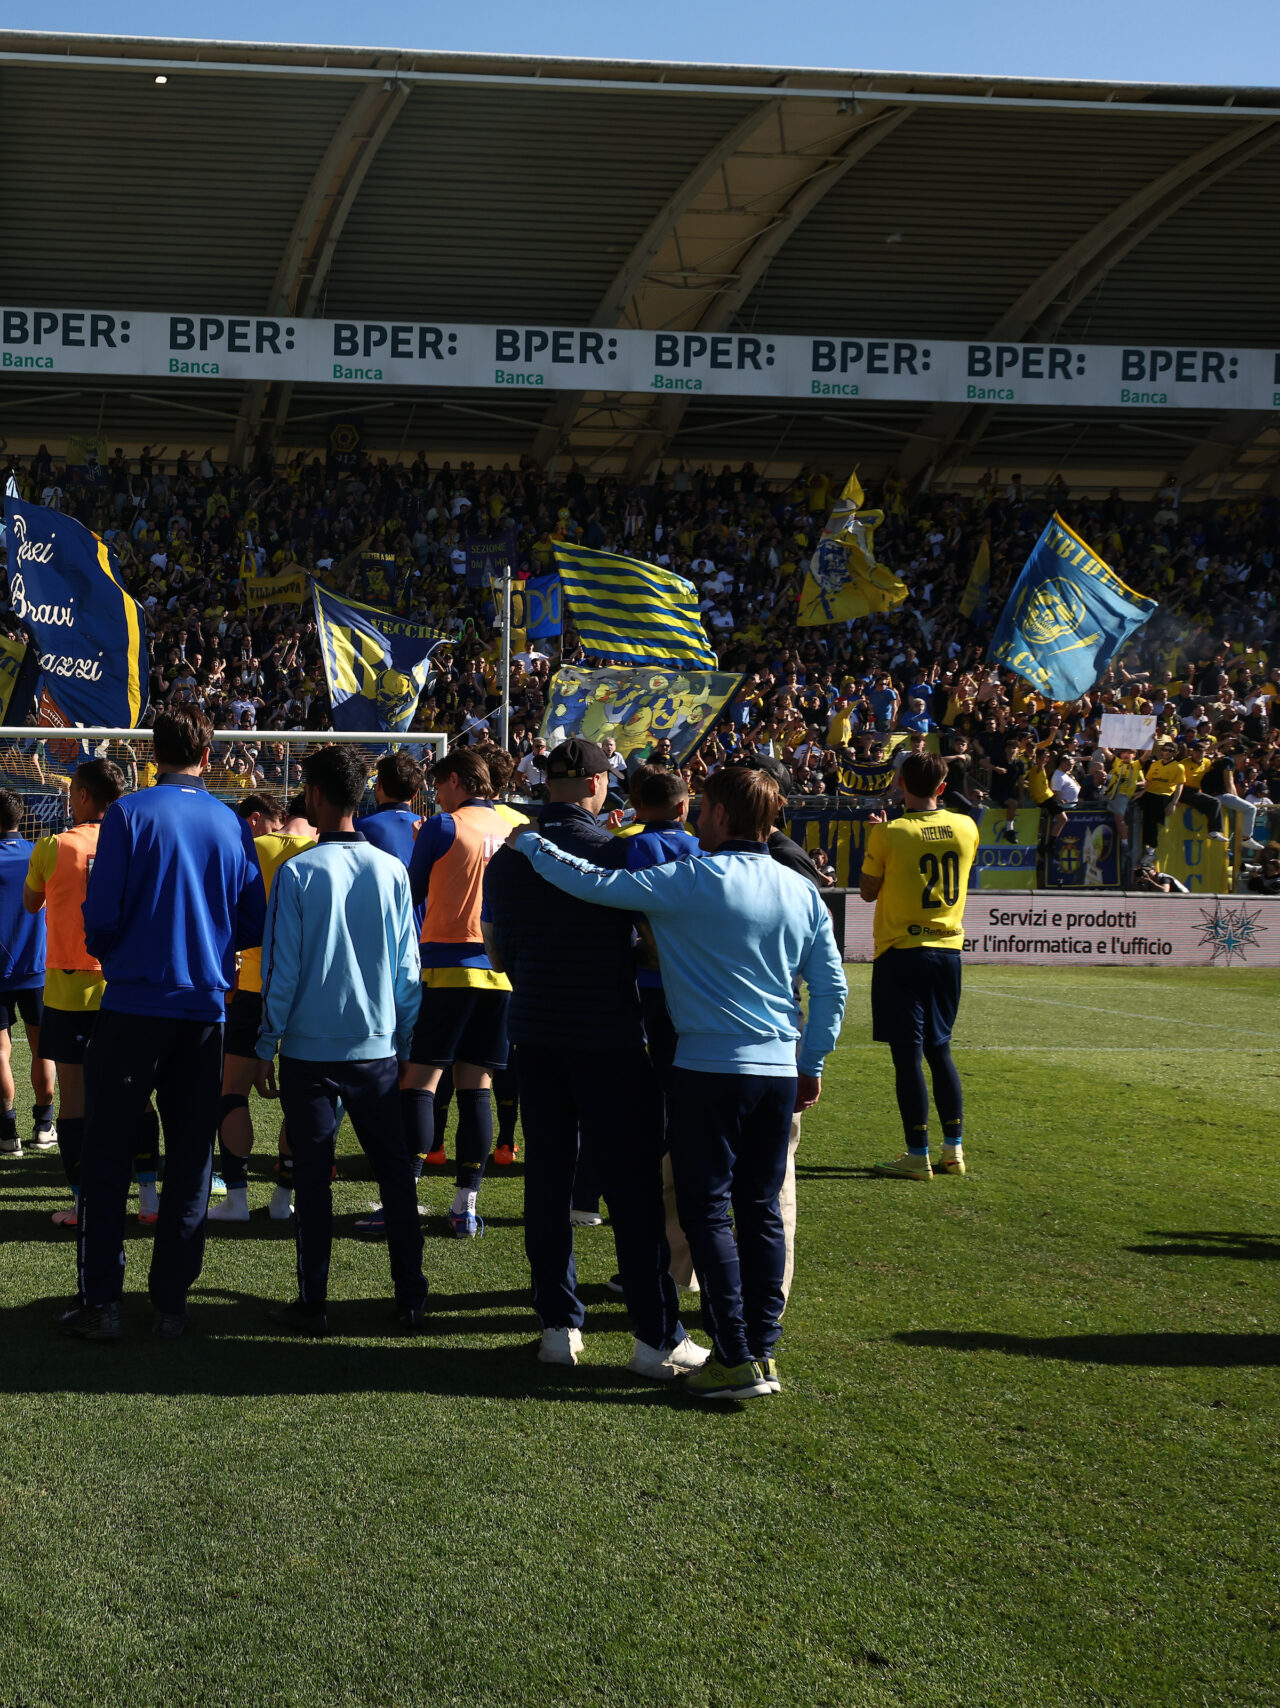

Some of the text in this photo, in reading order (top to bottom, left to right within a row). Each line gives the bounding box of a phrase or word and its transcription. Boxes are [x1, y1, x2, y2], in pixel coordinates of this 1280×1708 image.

[2, 352, 54, 367] Banca
[169, 358, 219, 373] Banca
[333, 364, 383, 378] Banca
[495, 369, 544, 383] Banca
[653, 374, 702, 388] Banca
[812, 380, 859, 392] Banca
[968, 384, 1014, 397] Banca
[1121, 389, 1168, 401] Banca
[471, 542, 507, 554] SEZIONE
[11, 572, 75, 627] Bravi
[33, 651, 104, 682] azzi
[921, 825, 953, 841] NIELING
[920, 850, 960, 909] 20
[989, 909, 1137, 932] Servizi e prodotti
[963, 936, 1172, 956] er l'informatica e l'ufficio
